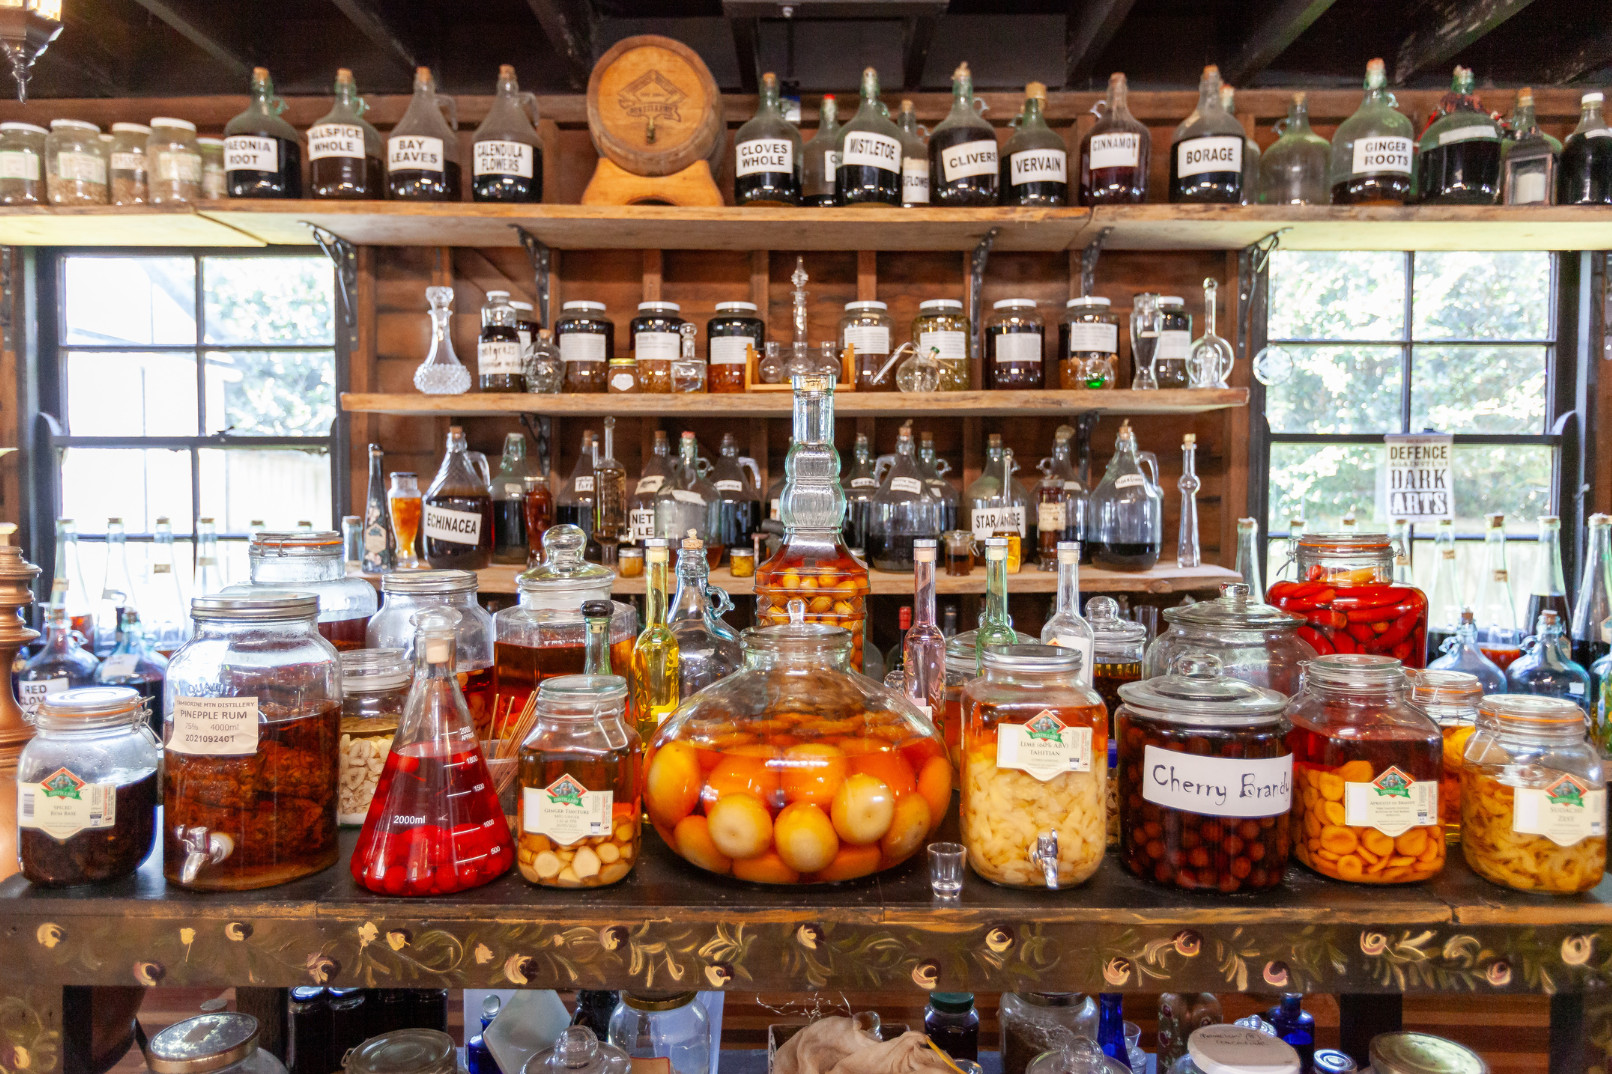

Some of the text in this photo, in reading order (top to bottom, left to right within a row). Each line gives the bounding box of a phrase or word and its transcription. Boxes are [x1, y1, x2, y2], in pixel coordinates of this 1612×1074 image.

[314, 141, 354, 152] WHOLE
[399, 140, 424, 150] BAY
[477, 143, 523, 158] CALENDULA
[741, 143, 788, 156] CLOVES
[850, 137, 895, 160] MISTLETOE
[1092, 137, 1137, 152] CINNAMON
[1365, 141, 1407, 153] GINGER
[229, 154, 259, 165] ROOT
[391, 152, 437, 164] LEAVES
[742, 155, 785, 168] WHOLE
[949, 151, 997, 168] CLIVERS
[1186, 148, 1233, 164] BORAGE
[1365, 155, 1408, 166] ROOTS
[481, 158, 520, 172] FLOWERS
[1016, 157, 1061, 174] VERVAIN
[1390, 446, 1447, 460] DEFENCE
[1391, 469, 1446, 489] DARK
[1391, 492, 1448, 515] ARTS
[427, 512, 477, 535] ECHINACEA
[976, 514, 996, 528] STAR
[25, 685, 47, 694] RED
[20, 696, 46, 705] CLOV
[180, 709, 247, 720] PINEPPLE RUM
[185, 734, 235, 743] 2021092401
[1153, 763, 1227, 806] Cherry
[393, 815, 426, 824] 2000ml
